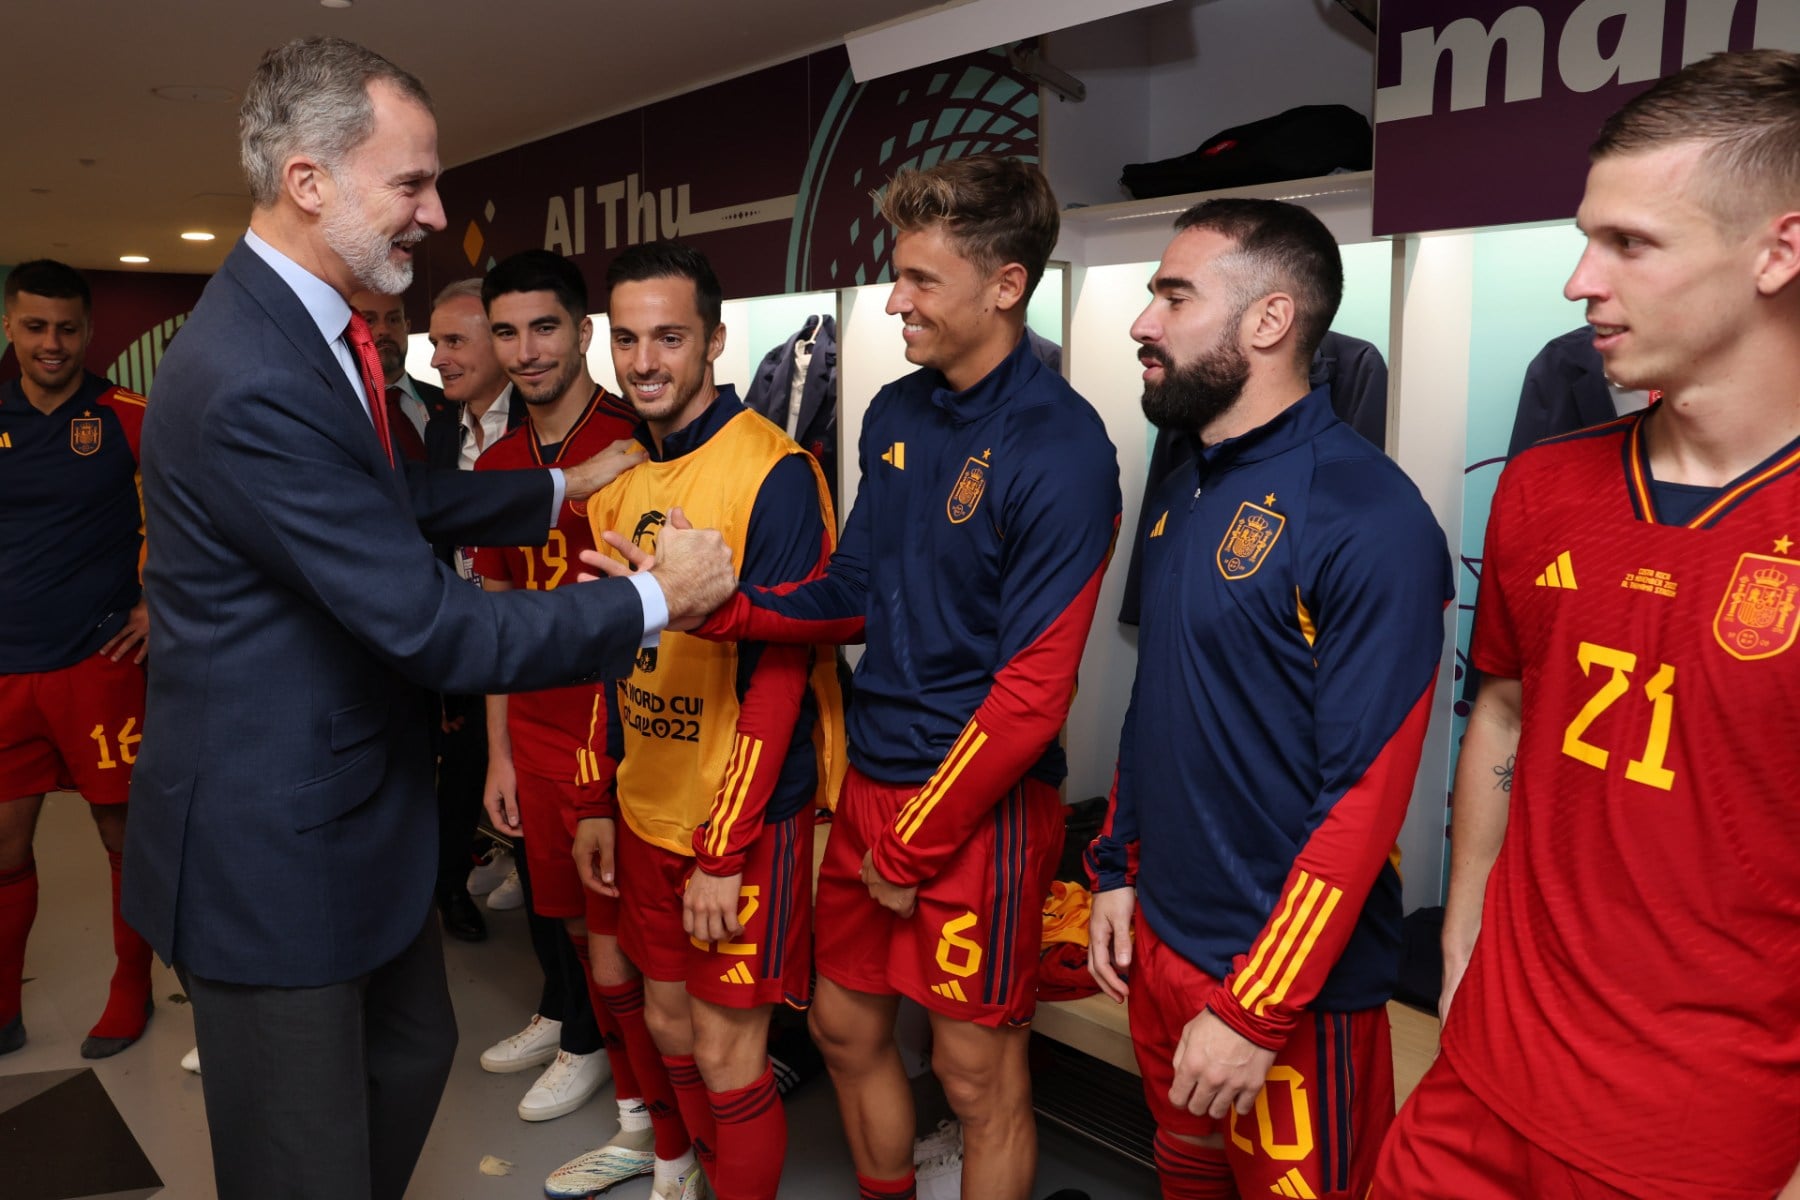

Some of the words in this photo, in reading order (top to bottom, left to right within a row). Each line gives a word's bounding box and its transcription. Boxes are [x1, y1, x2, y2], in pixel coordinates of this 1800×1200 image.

[544, 186, 585, 257] Al
[597, 173, 691, 249] Thu
[518, 530, 568, 591] 19
[90, 717, 143, 769] 16
[1562, 641, 1676, 791] 21
[685, 879, 760, 955] 2
[936, 910, 983, 978] 6
